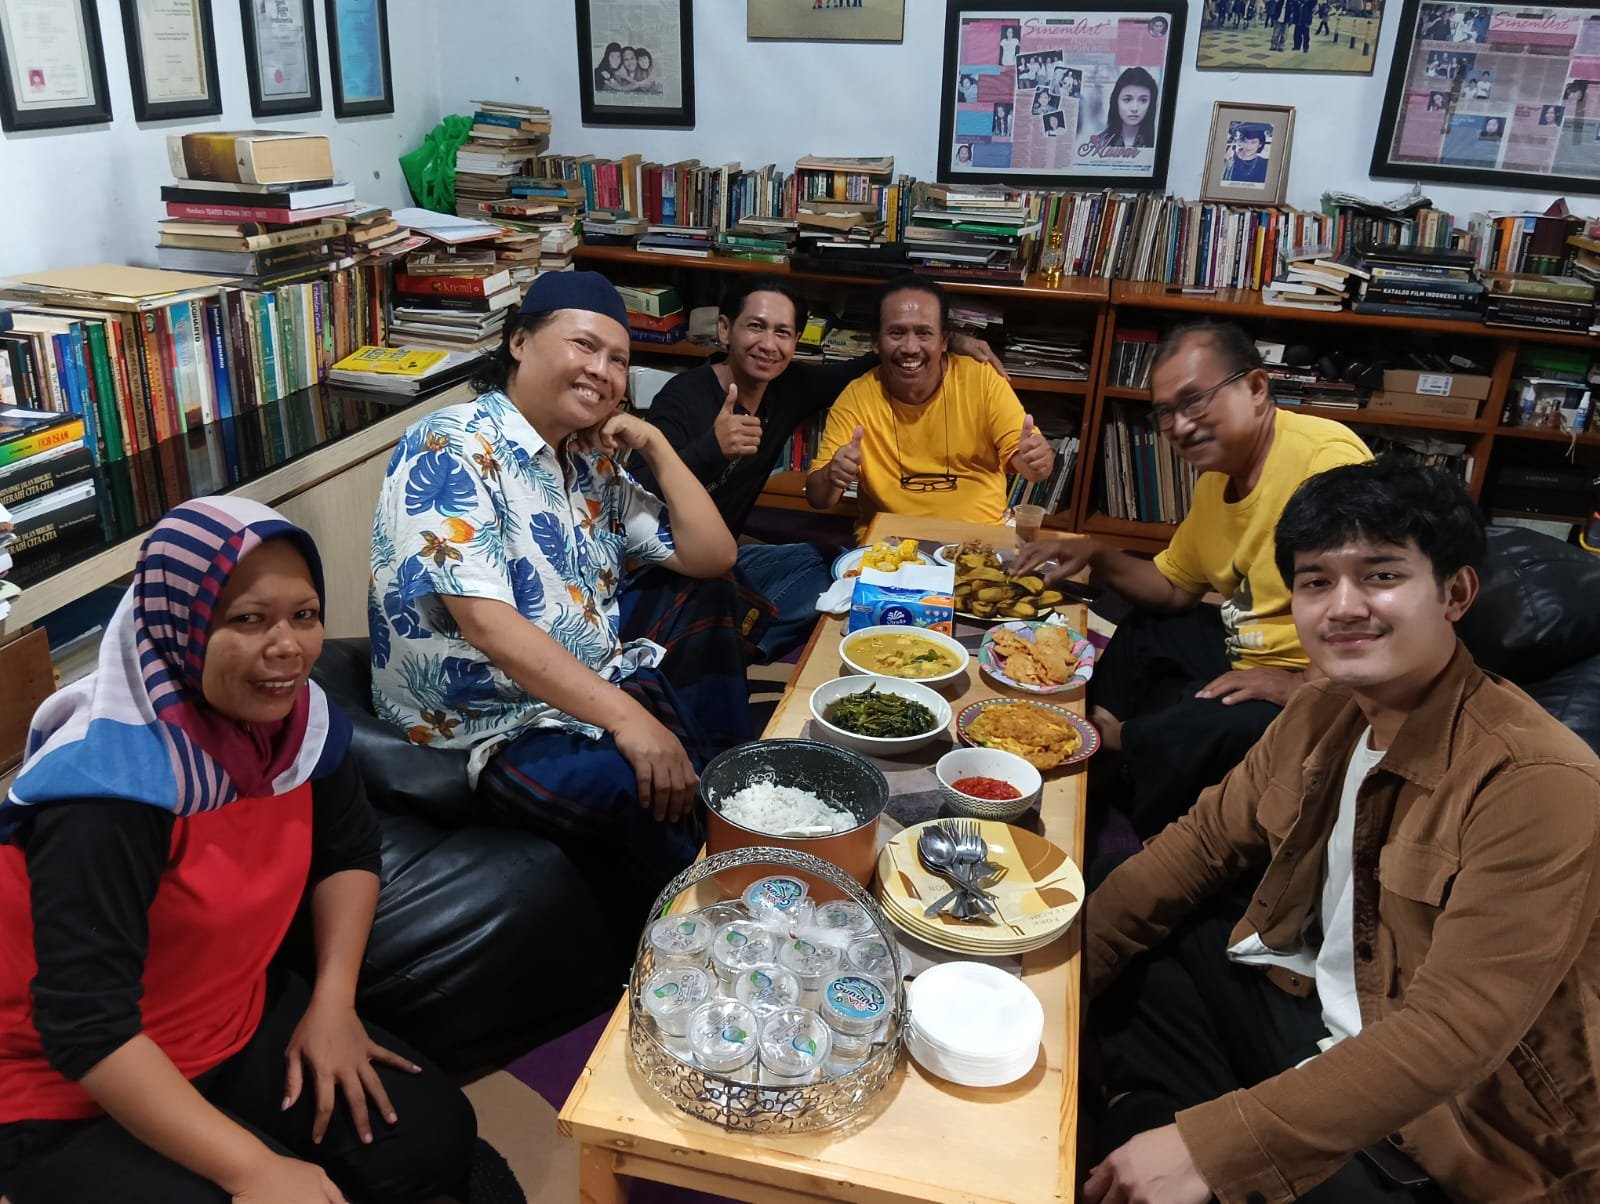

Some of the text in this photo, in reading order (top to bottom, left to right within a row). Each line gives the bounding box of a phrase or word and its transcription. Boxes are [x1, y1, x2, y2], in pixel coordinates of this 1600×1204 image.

[1022, 17, 1111, 38] SinemArt
[1382, 288, 1410, 296] KATALOG
[1426, 291, 1457, 300] INDONESIA
[1535, 316, 1571, 327] INDONESIA
